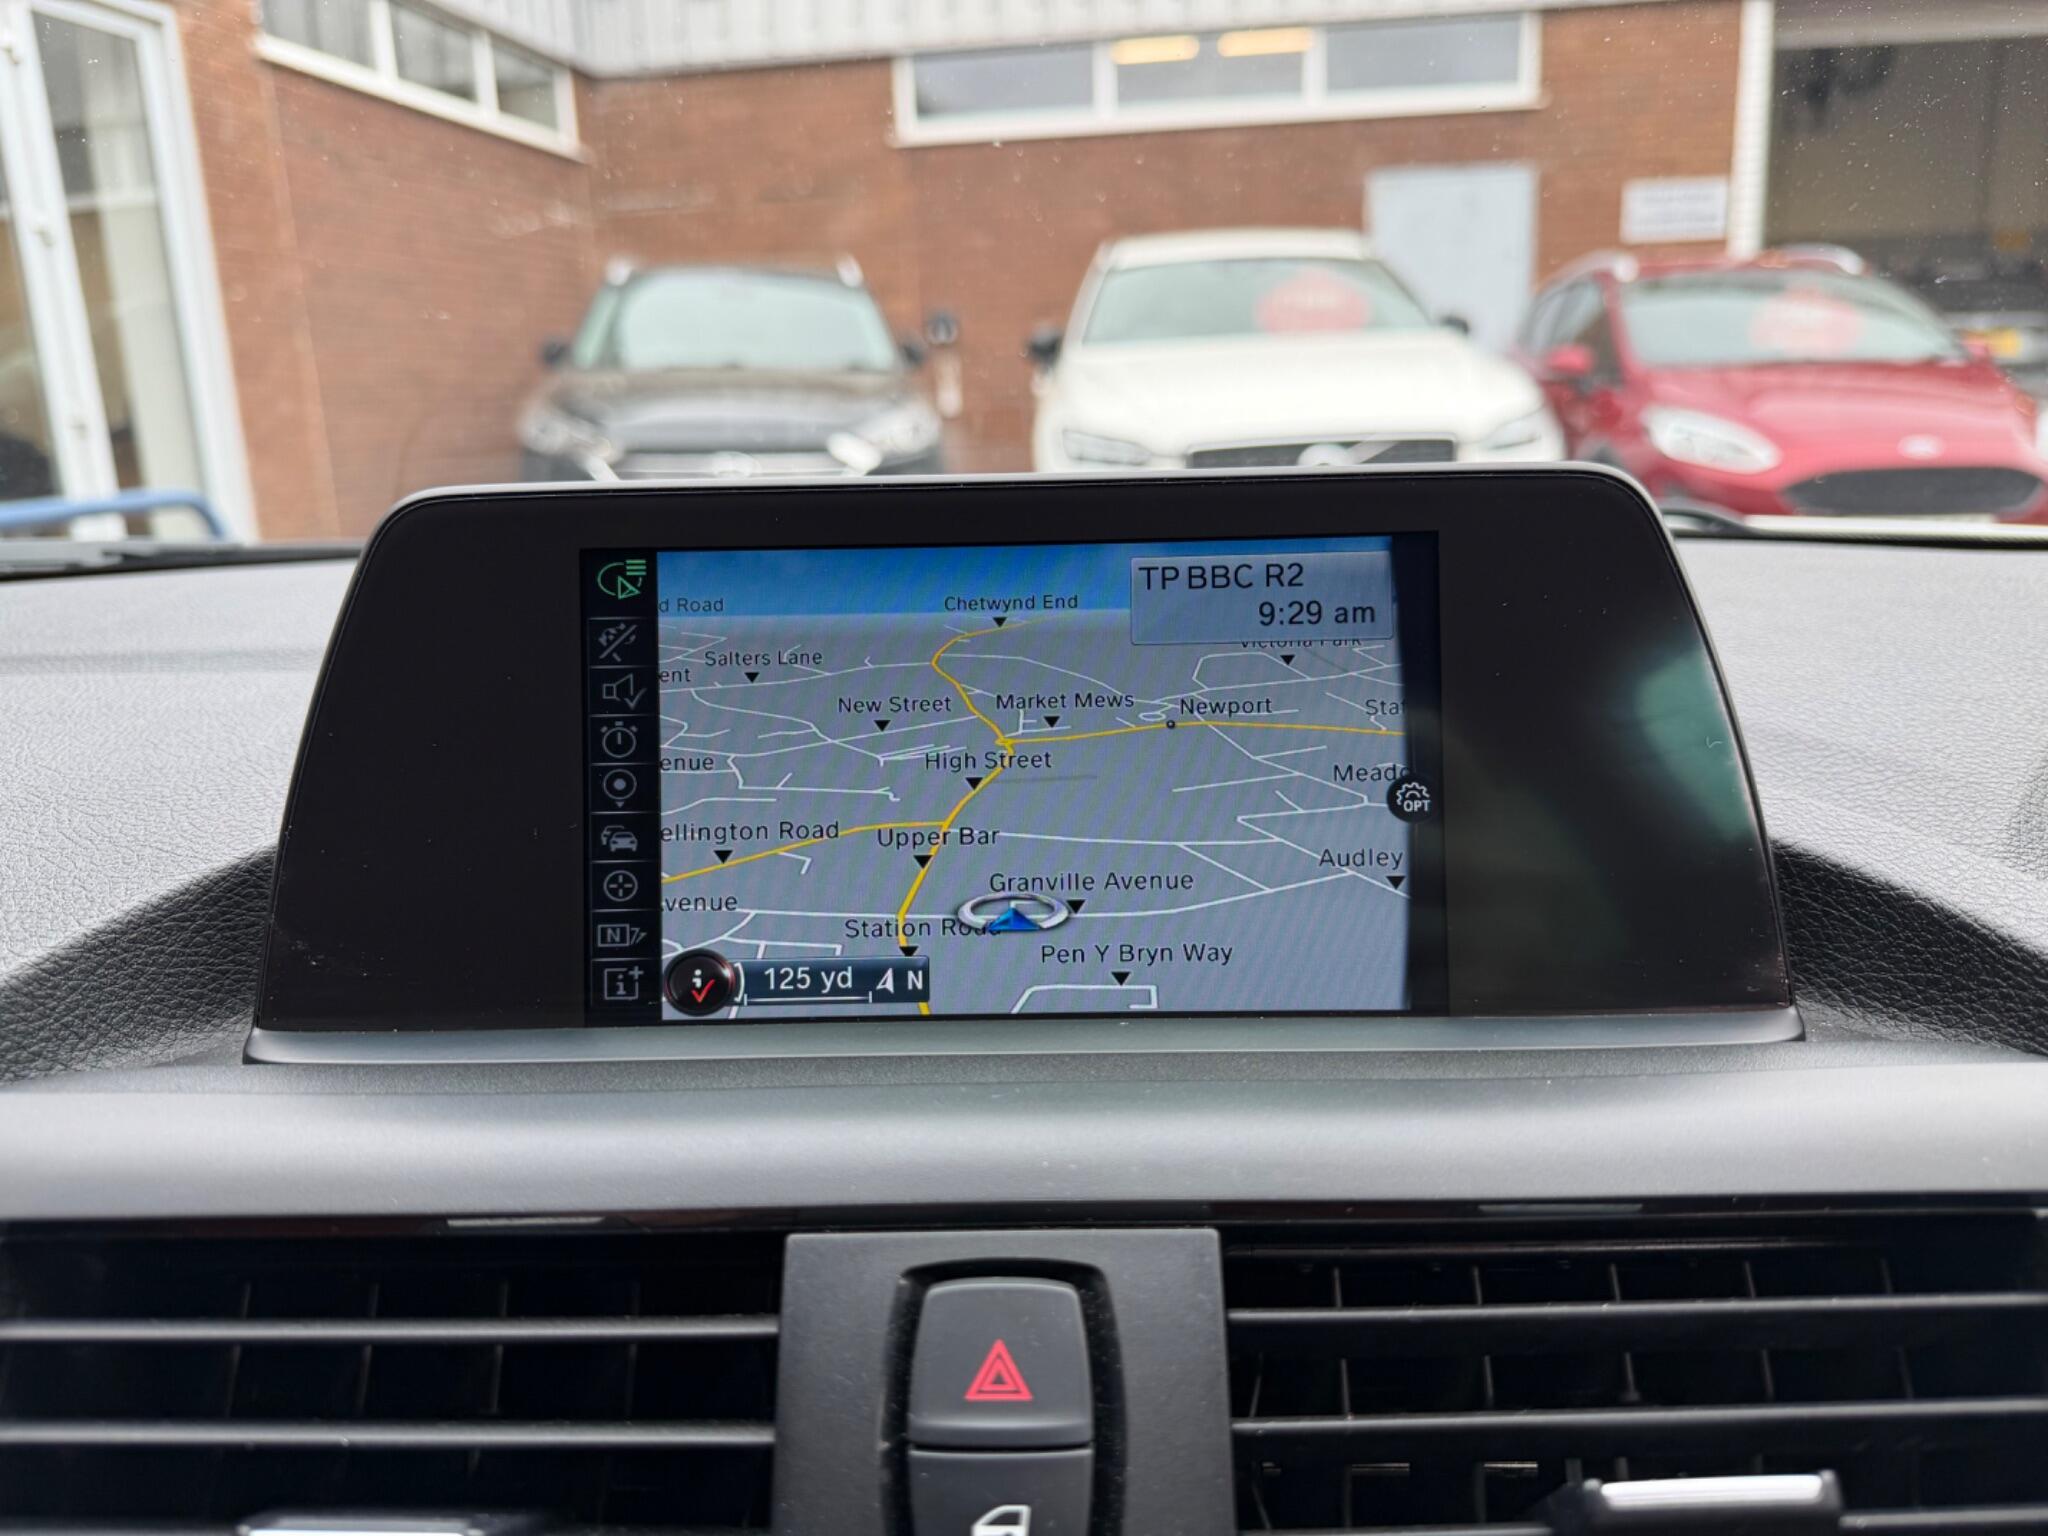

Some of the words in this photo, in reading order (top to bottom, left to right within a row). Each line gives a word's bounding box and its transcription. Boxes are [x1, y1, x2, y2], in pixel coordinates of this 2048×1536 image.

[1138, 566, 1180, 590] TP
[1187, 564, 1253, 589] BBC
[1265, 563, 1304, 587] R2
[677, 598, 724, 612] Road
[944, 596, 1036, 612] Chetwynd
[1043, 594, 1078, 609] End
[1258, 600, 1322, 626] 9:29
[1334, 605, 1376, 624] am
[704, 651, 771, 666] Salters
[777, 650, 823, 665] Lane
[838, 697, 882, 713] New
[889, 695, 951, 712] Street
[996, 694, 1067, 709] Market
[1074, 692, 1135, 708] Mews
[1179, 698, 1272, 717] Newport
[925, 751, 976, 773] High
[984, 750, 1053, 769] Street
[1403, 800, 1430, 812] OPT
[779, 821, 839, 840] Road
[877, 828, 950, 850] Upper
[959, 826, 1000, 845] Bar
[1319, 849, 1404, 870] Audley
[989, 872, 1095, 892] Granville
[1104, 872, 1194, 890] Avenue
[845, 919, 931, 938] Station
[941, 918, 1000, 936] Roa
[1041, 945, 1085, 963] Pen
[1094, 945, 1108, 962] Y
[1120, 945, 1173, 966] Bryn
[1183, 944, 1233, 965] Way
[764, 967, 811, 990] 125
[820, 966, 853, 994] yd
[907, 970, 923, 989] N
